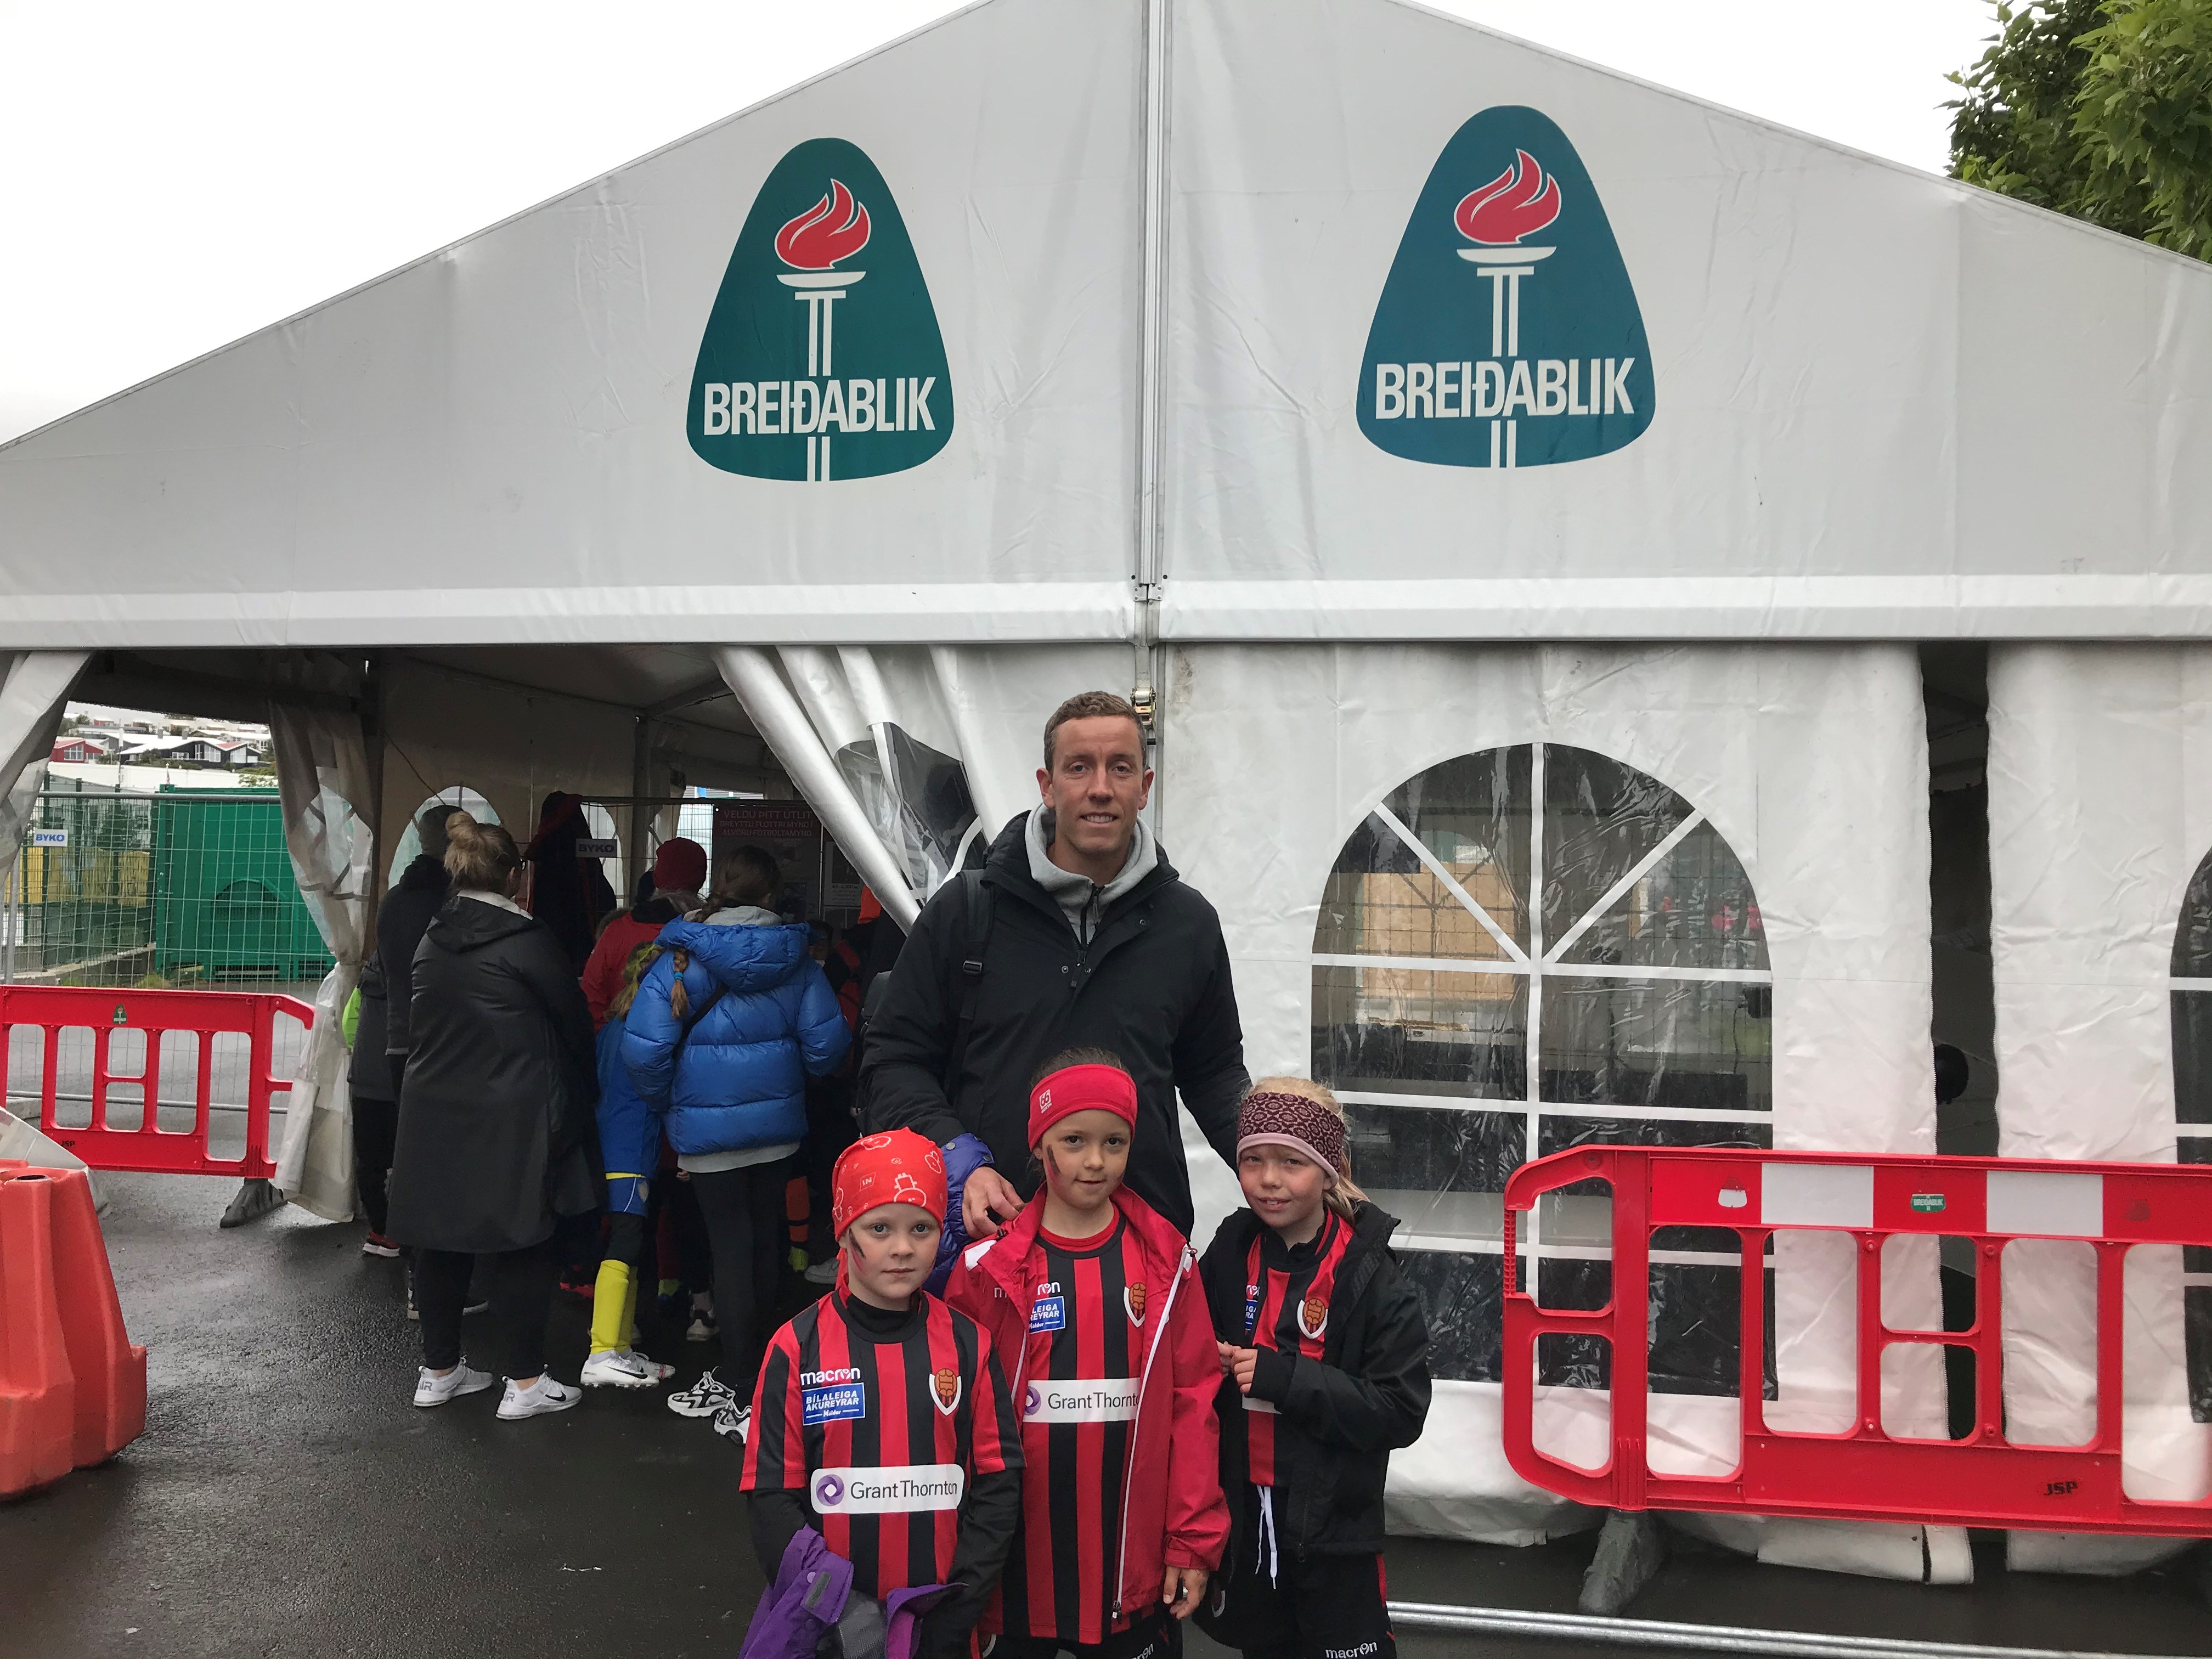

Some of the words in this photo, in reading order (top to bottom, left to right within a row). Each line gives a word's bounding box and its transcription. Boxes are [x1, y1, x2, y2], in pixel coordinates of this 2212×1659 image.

[1376, 357, 1635, 419] BREIÐABLIK
[704, 377, 936, 436] BREIÐABLIK
[724, 811, 755, 819] VELDU
[759, 811, 781, 819] ÞITT
[783, 809, 812, 819] ÚTLIT
[579, 844, 614, 853] BYKO
[1030, 1310, 1059, 1321] REYRAR
[1032, 1304, 1058, 1313] LEIGA
[800, 1368, 861, 1386] macron
[805, 1397, 859, 1412] AKUREYRAR
[806, 1390, 857, 1404] BÍLALEIGA
[1048, 1393, 1092, 1409] Grant
[1093, 1392, 1140, 1408] Thornt
[850, 1481, 898, 1499] Grant
[900, 1480, 957, 1497] Thornton
[2044, 1481, 2078, 1496] JSP
[1325, 1642, 1378, 1658] macron
